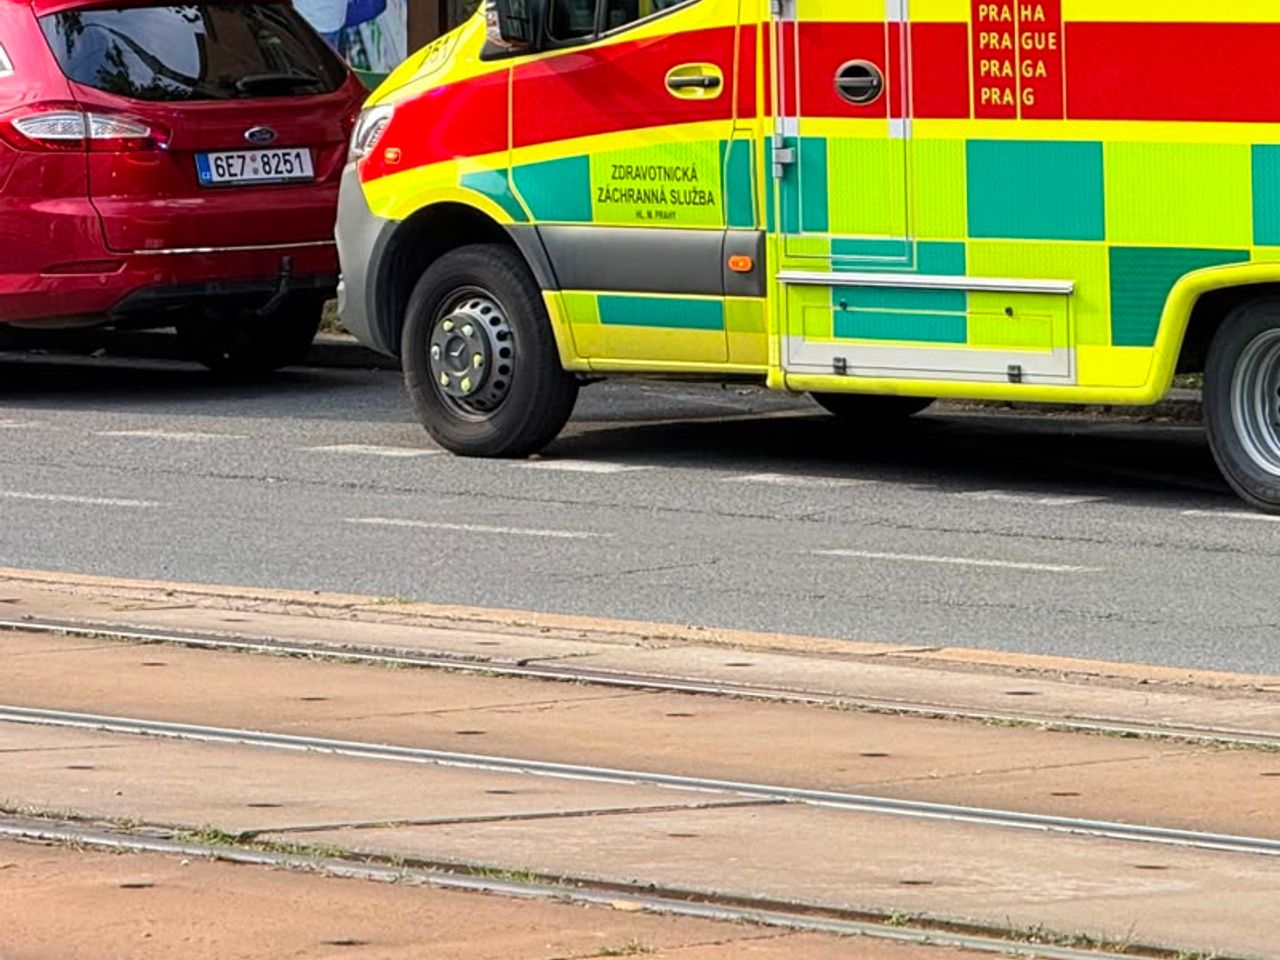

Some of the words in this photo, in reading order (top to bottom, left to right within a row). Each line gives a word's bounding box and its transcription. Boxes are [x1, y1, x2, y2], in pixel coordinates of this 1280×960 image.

[214, 154, 246, 178] 6E7
[261, 152, 304, 175] 8251
[611, 162, 698, 182] ZDRAVOTNICKÁ
[598, 184, 667, 204] ZÁCHRANNÁ
[671, 186, 715, 206] SLUŽBA
